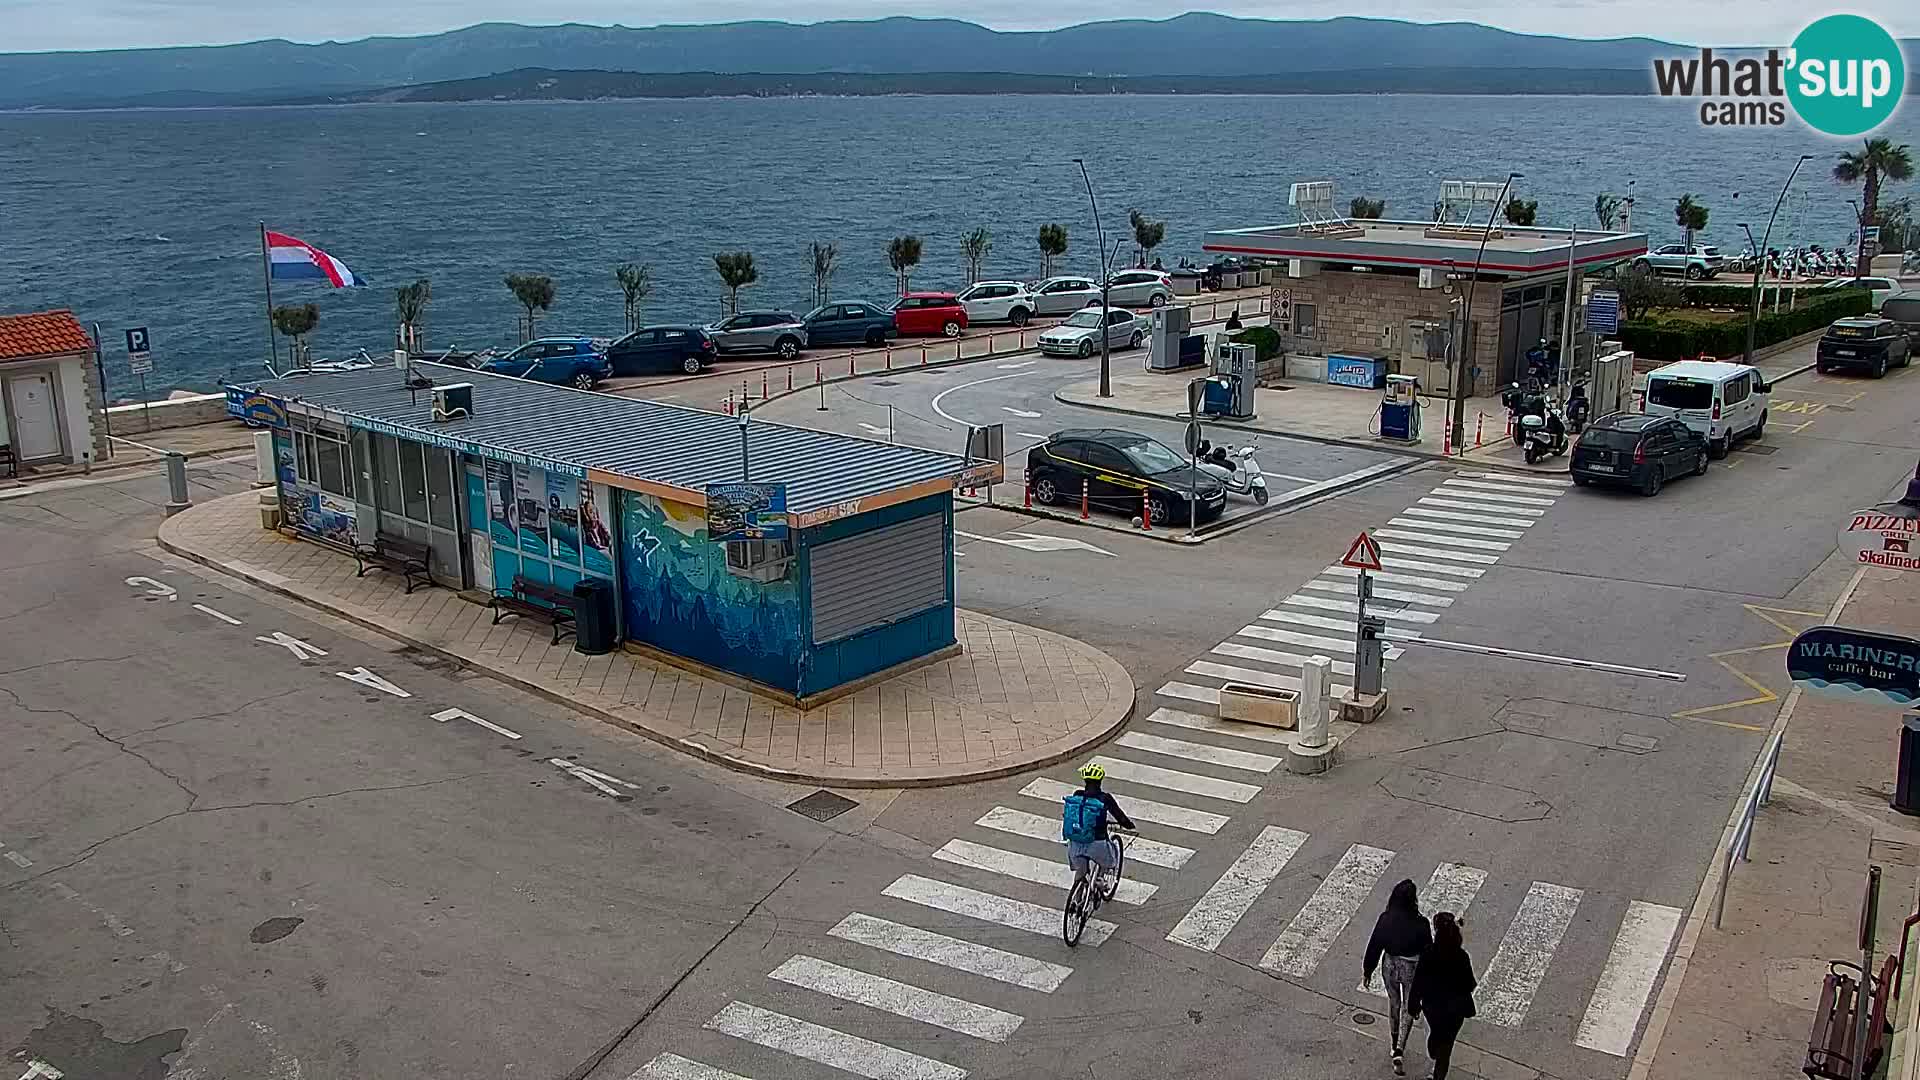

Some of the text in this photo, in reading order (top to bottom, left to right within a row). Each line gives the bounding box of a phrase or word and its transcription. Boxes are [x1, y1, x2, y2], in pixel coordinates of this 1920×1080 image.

[131, 331, 143, 350] P
[397, 428, 437, 444] AUTOBUSNA
[437, 436, 469, 452] POSTAJA
[479, 446, 494, 457] BUS
[495, 449, 527, 465] STATION
[528, 456, 555, 471] TICKET
[555, 463, 583, 477] OFFICE
[1880, 530, 1916, 541] GRILL
[1828, 662, 1896, 680] caffe bar
